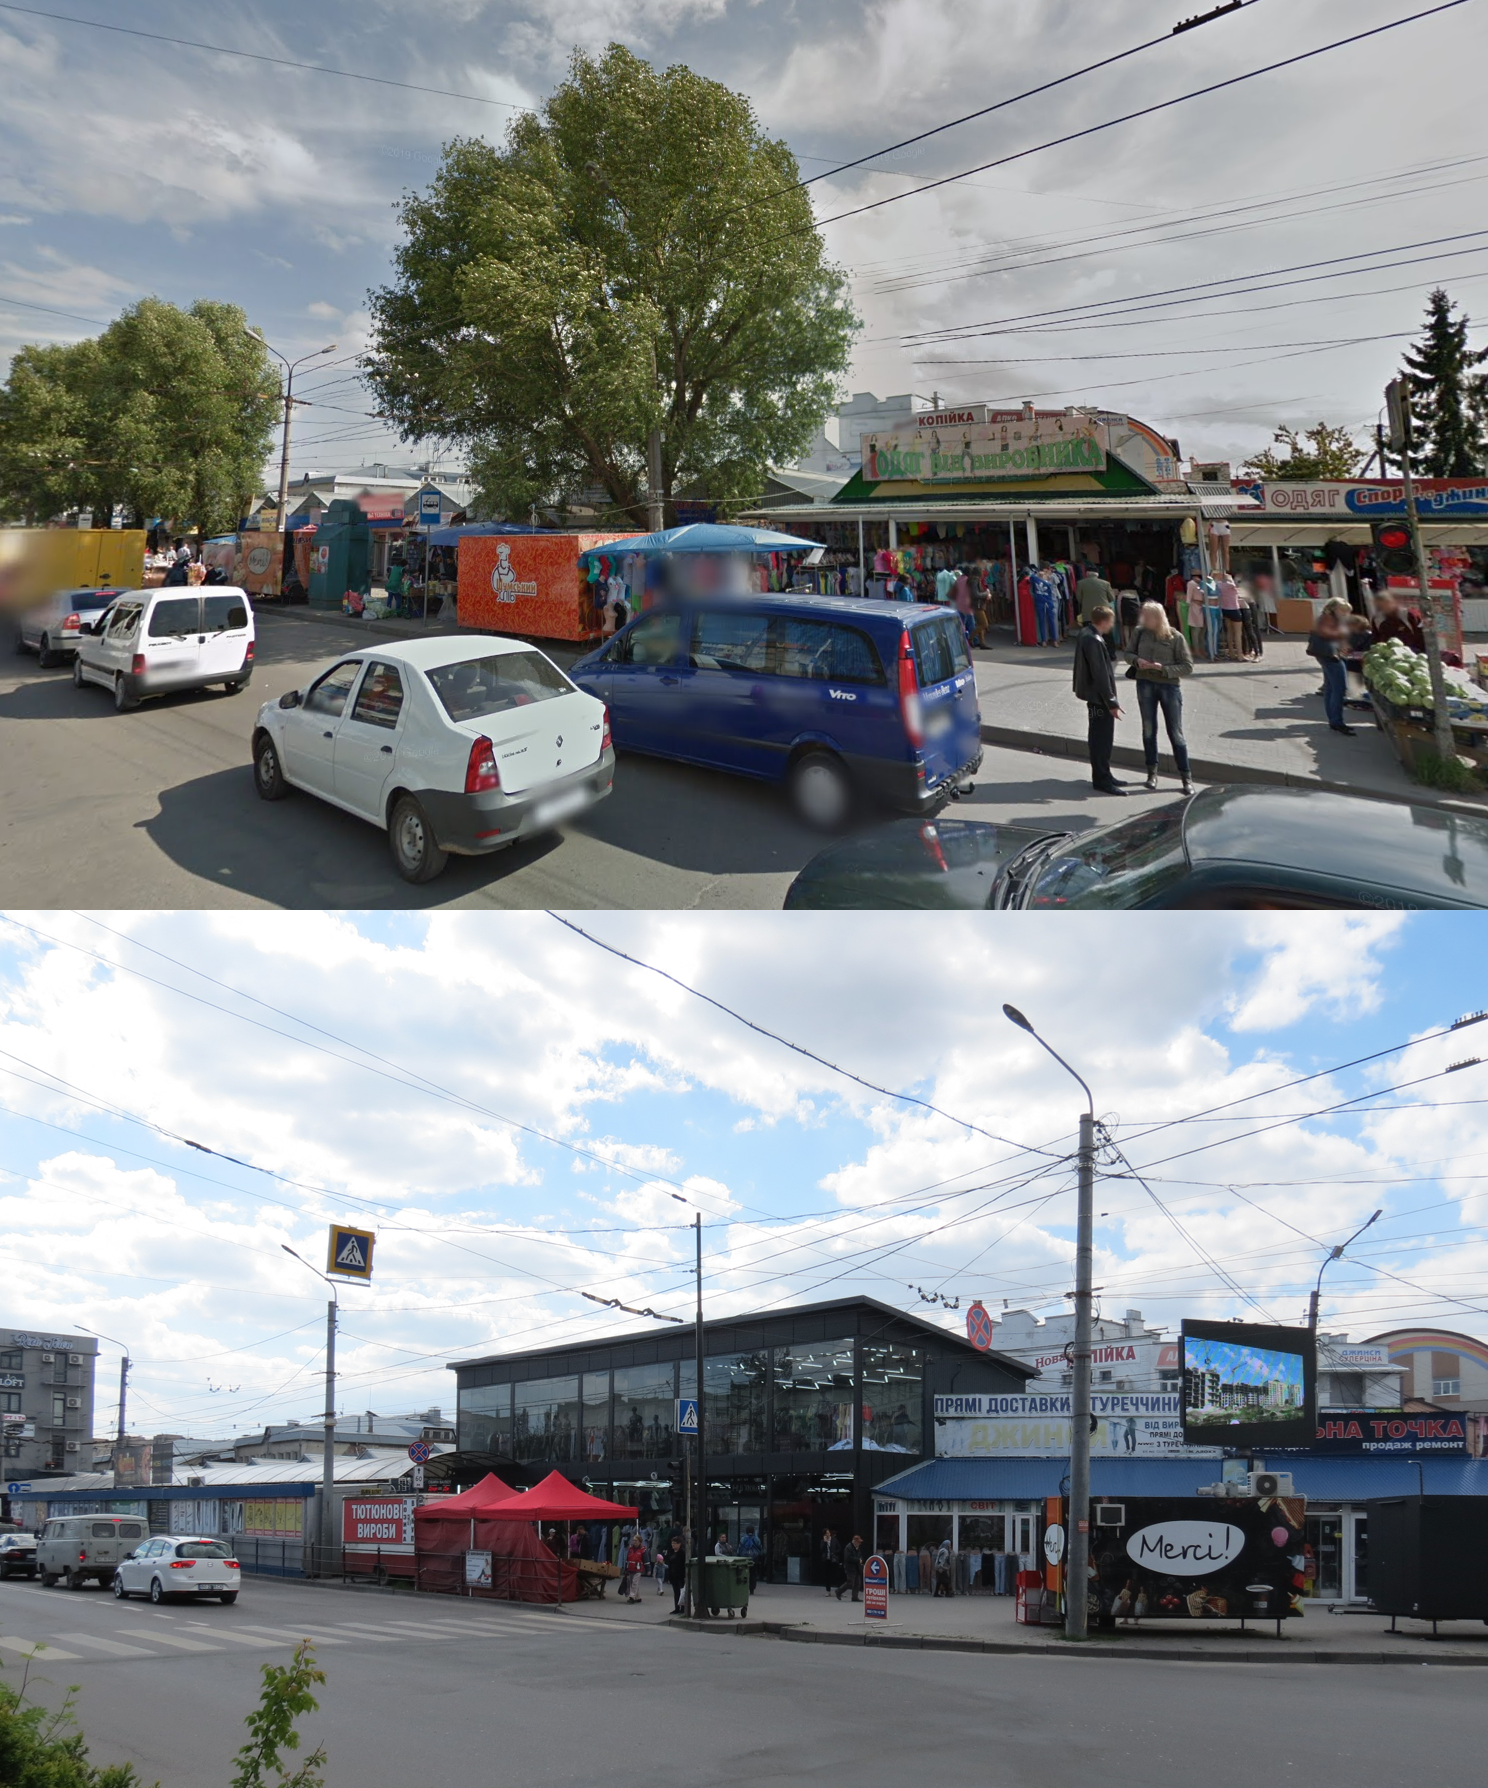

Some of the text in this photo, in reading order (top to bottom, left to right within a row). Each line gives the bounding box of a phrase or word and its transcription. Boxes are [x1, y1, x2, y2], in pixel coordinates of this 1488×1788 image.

[918, 411, 975, 427] КОПІЙКА
[971, 437, 1104, 471] ВИРОБНИКА
[1271, 489, 1340, 511] ОДЯГ
[934, 1397, 982, 1413] ПРЯМІ
[986, 1396, 1070, 1414] ДОСТАВКИ
[1144, 1421, 1180, 1430] ВІД ВИР
[1316, 1419, 1465, 1439] ЬНА ТОЧКА
[1149, 1431, 1184, 1439] ПРЯМІ ДО
[1362, 1441, 1464, 1450] продаж ремонт
[351, 1503, 403, 1520] ТЮТЮНОВІ
[970, 1501, 996, 1510] СВІТ
[357, 1523, 396, 1539] ВИРОБИ
[1139, 1525, 1231, 1561] Merci!
[865, 1587, 886, 1596] ГРОШІ
